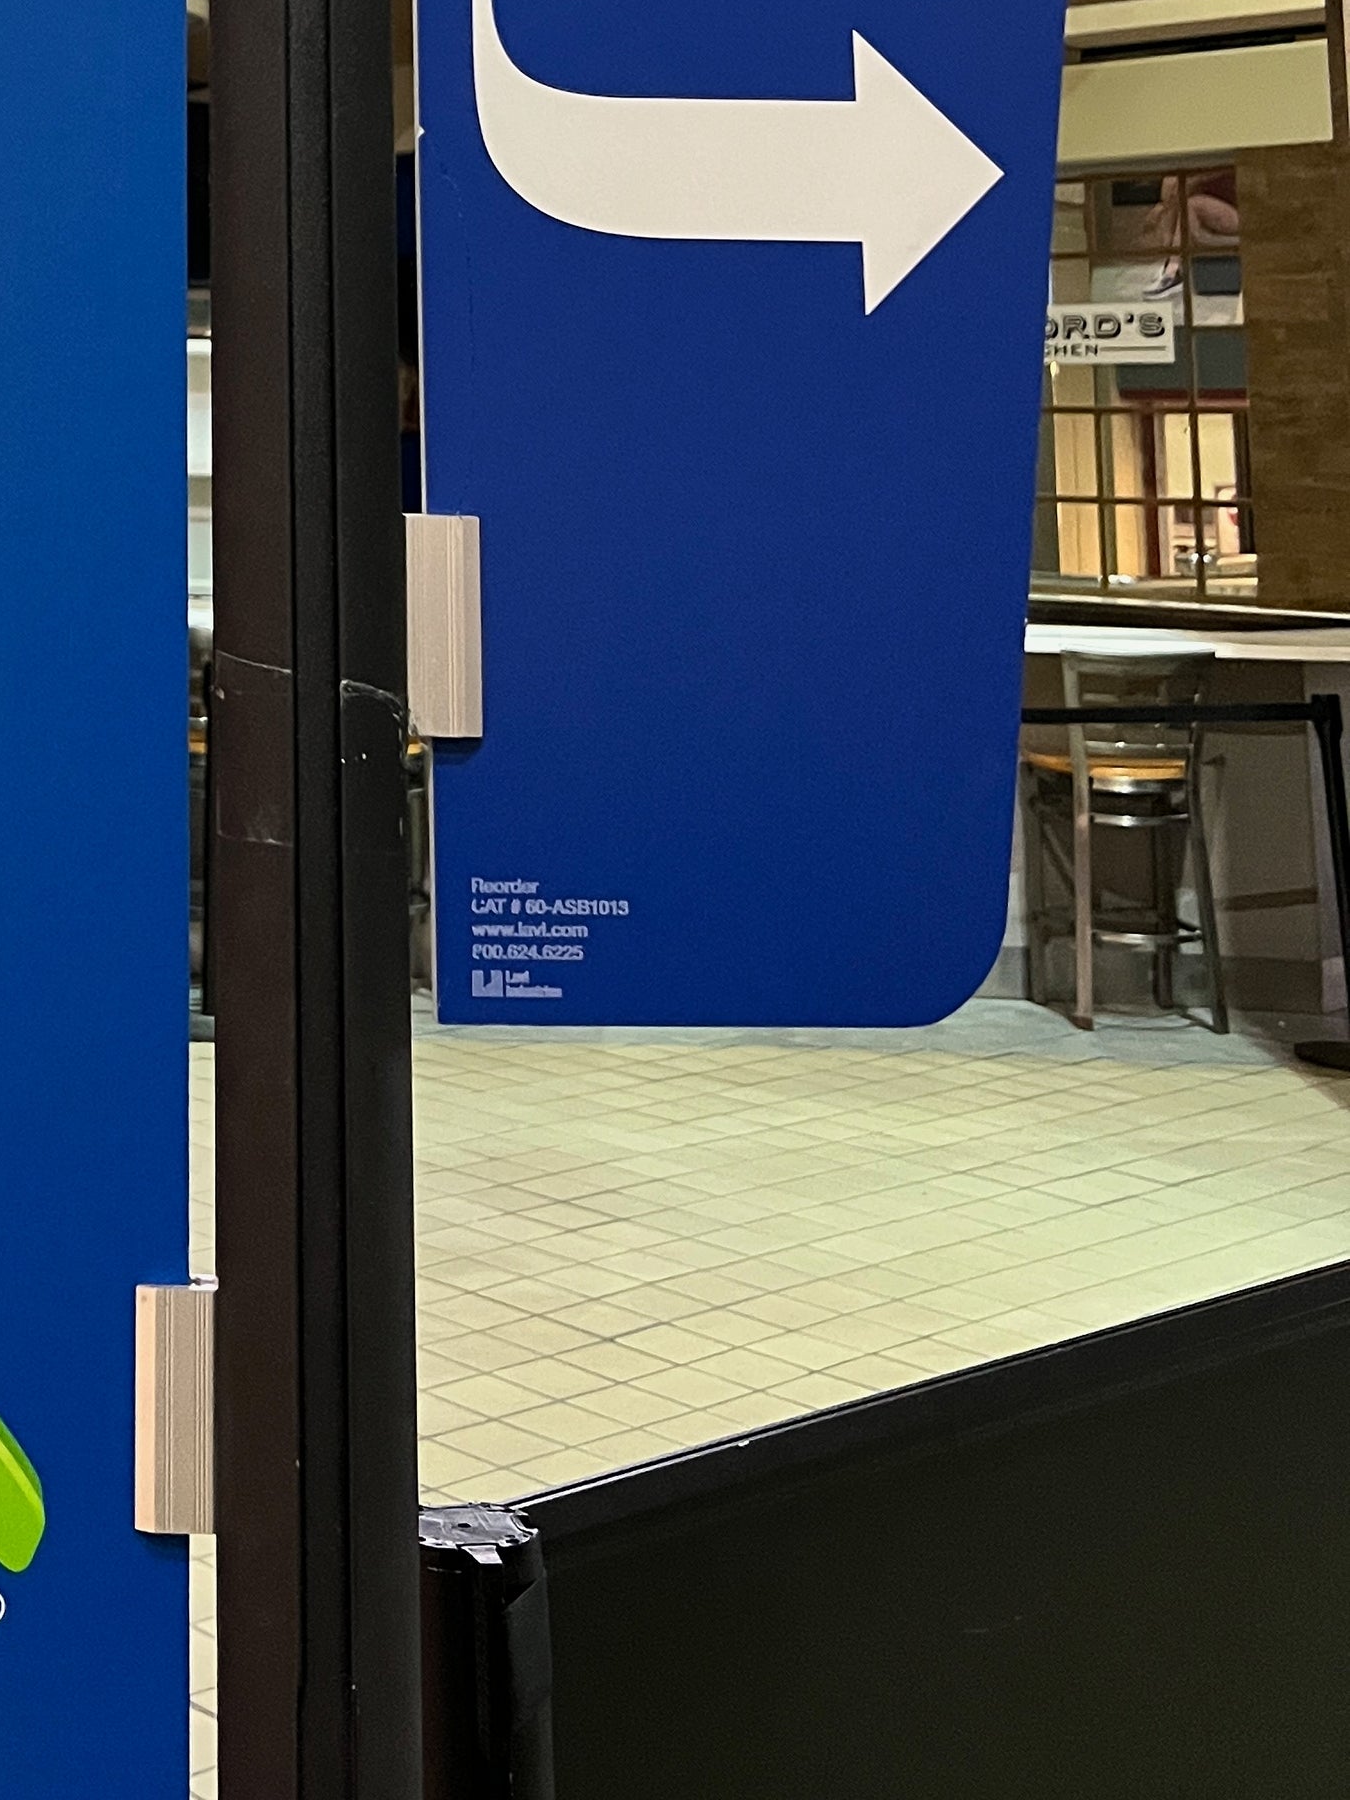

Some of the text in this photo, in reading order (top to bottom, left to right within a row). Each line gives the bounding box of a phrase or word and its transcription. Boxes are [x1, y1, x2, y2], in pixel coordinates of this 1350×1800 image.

[471, 878, 539, 894] Reorder
[471, 898, 507, 914] CAT
[525, 899, 629, 915] 60-ASB1013
